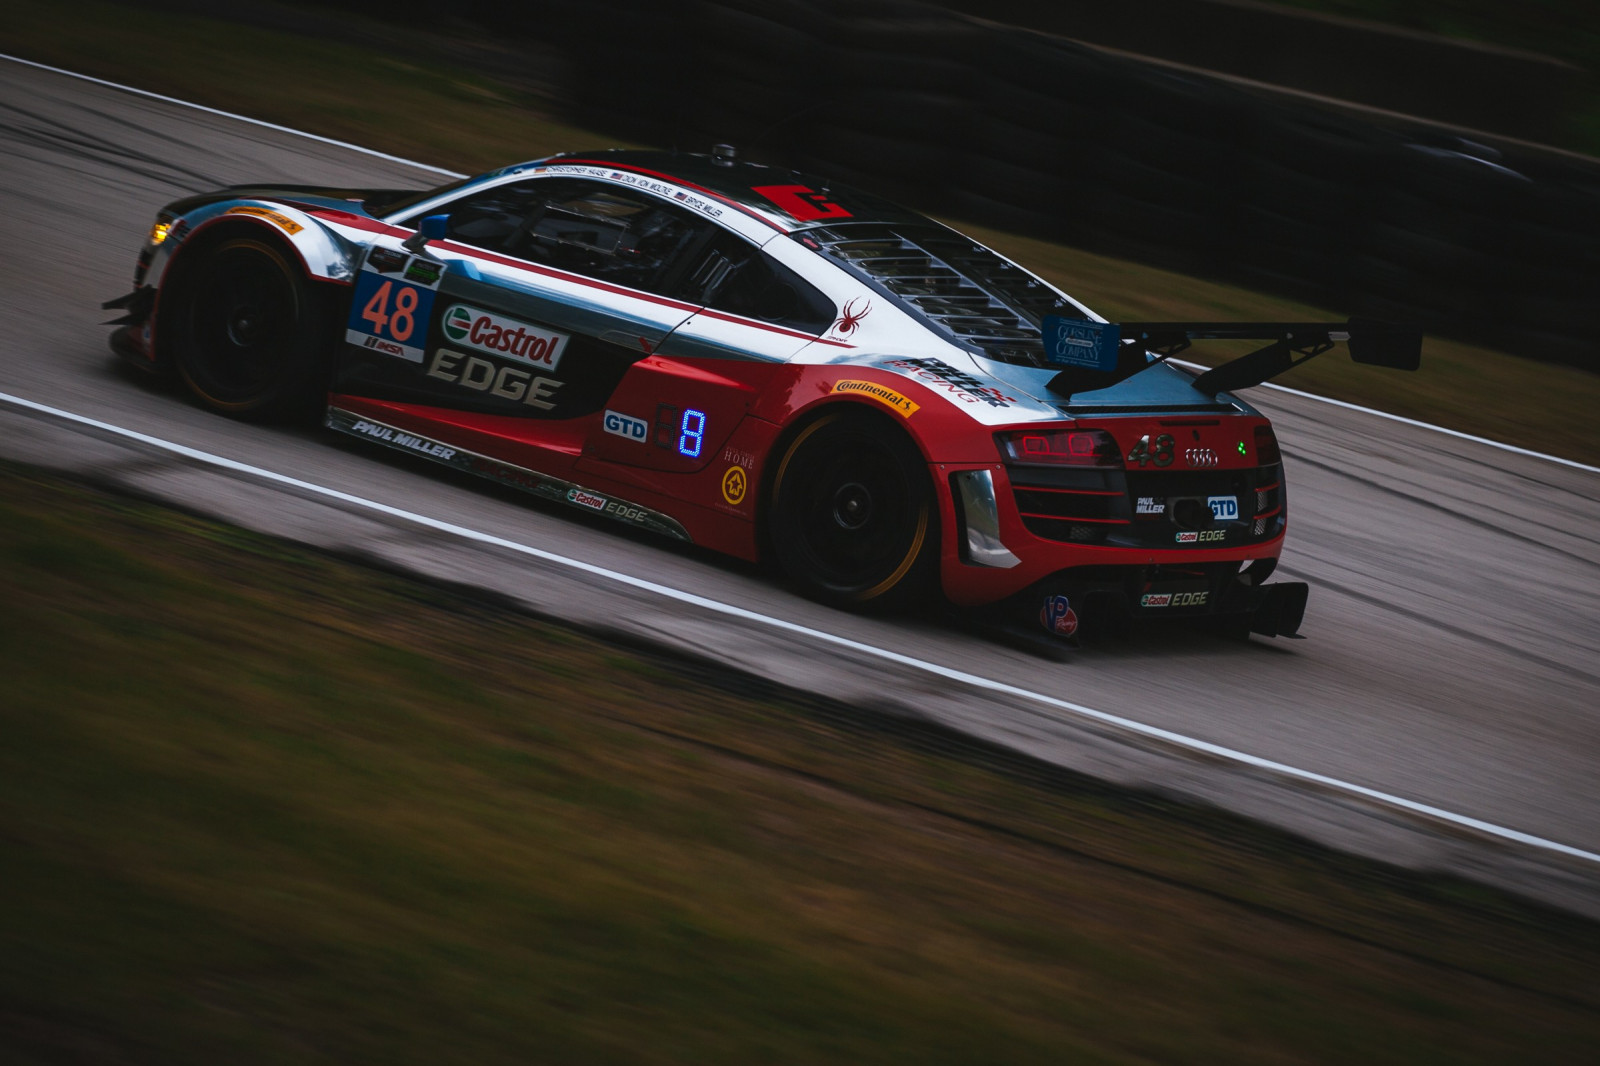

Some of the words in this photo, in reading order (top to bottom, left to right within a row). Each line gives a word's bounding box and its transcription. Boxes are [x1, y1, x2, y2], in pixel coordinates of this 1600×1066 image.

[361, 280, 419, 341] 48
[470, 316, 559, 365] Castrol
[426, 348, 567, 410] EDGE
[836, 381, 904, 406] Continental
[883, 360, 981, 403] RACING
[351, 420, 394, 441] PAUL
[392, 432, 458, 460] MILLER
[605, 414, 646, 438] GTD
[680, 408, 706, 457] 8
[724, 450, 755, 469] HOME
[1127, 434, 1175, 467] 48
[576, 493, 603, 509] Castrol
[604, 502, 648, 522] EDGE
[1136, 504, 1165, 514] MILLER
[1209, 500, 1236, 516] GTD
[1199, 529, 1226, 541] EDGE
[1171, 591, 1209, 606] EDGE
